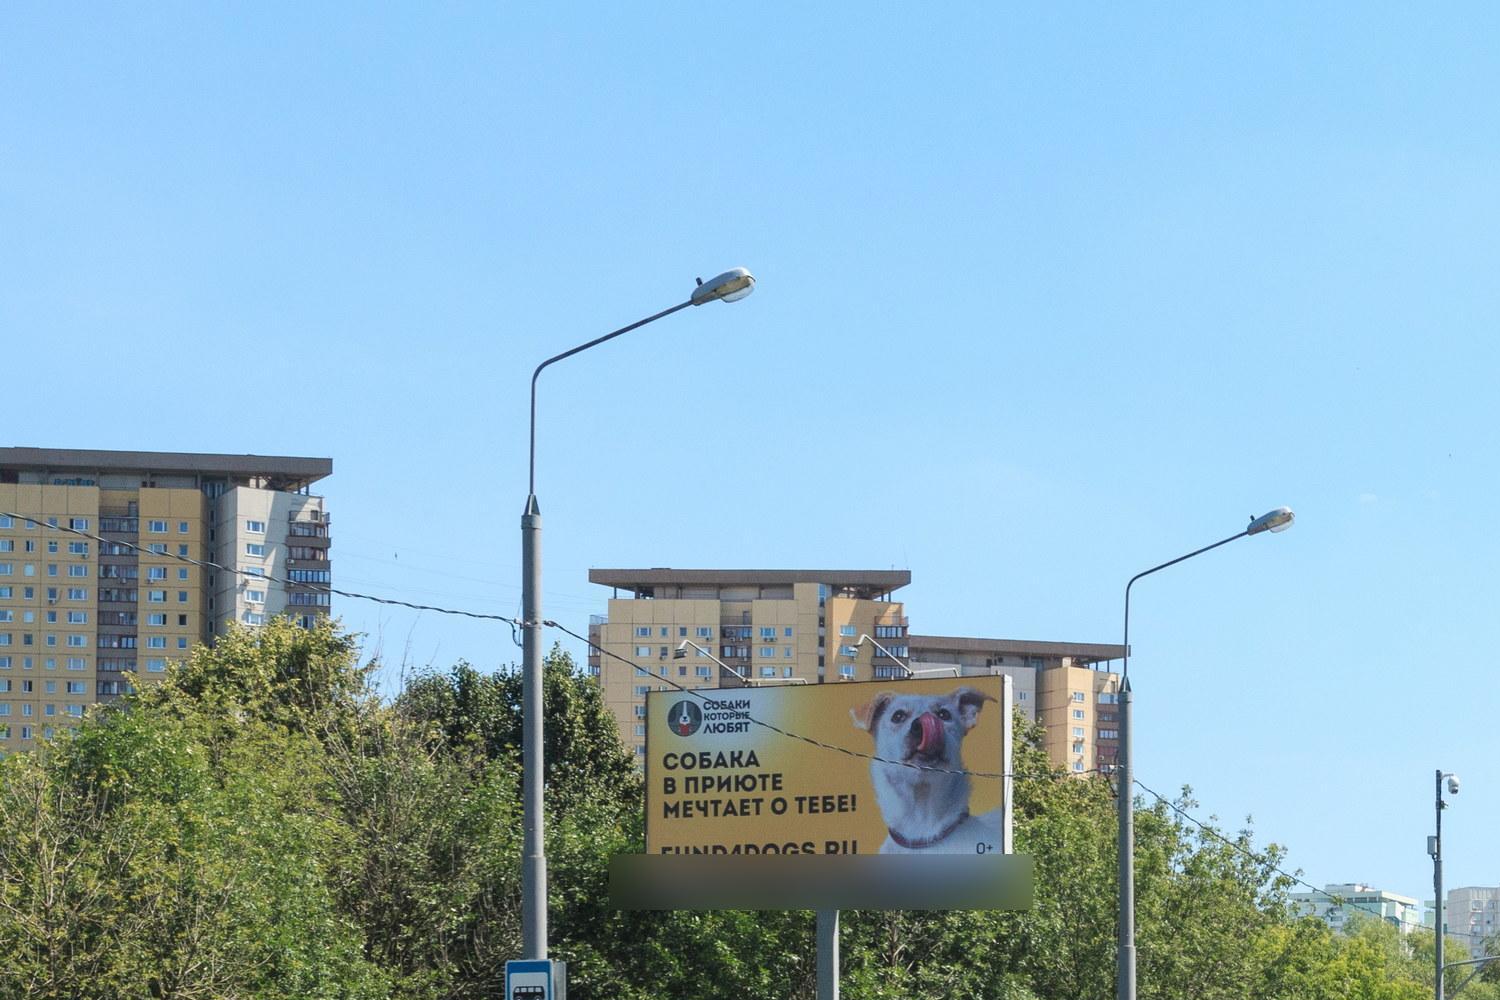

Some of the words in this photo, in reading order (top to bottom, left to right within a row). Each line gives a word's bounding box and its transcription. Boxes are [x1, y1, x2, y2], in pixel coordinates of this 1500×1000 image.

[703, 700, 750, 710] СОБАКИ
[703, 711, 750, 720] КОТОРЫЕ
[703, 721, 750, 734] ЛЮБЯТ
[663, 750, 760, 770] СОБАКА
[663, 776, 676, 795] В
[684, 773, 783, 794] ПРИЮТЕ
[663, 798, 764, 819] МЕЧТАЕТ
[770, 797, 788, 815] О
[794, 794, 857, 814] ТЕБЕ!
[976, 842, 993, 855] 0+
